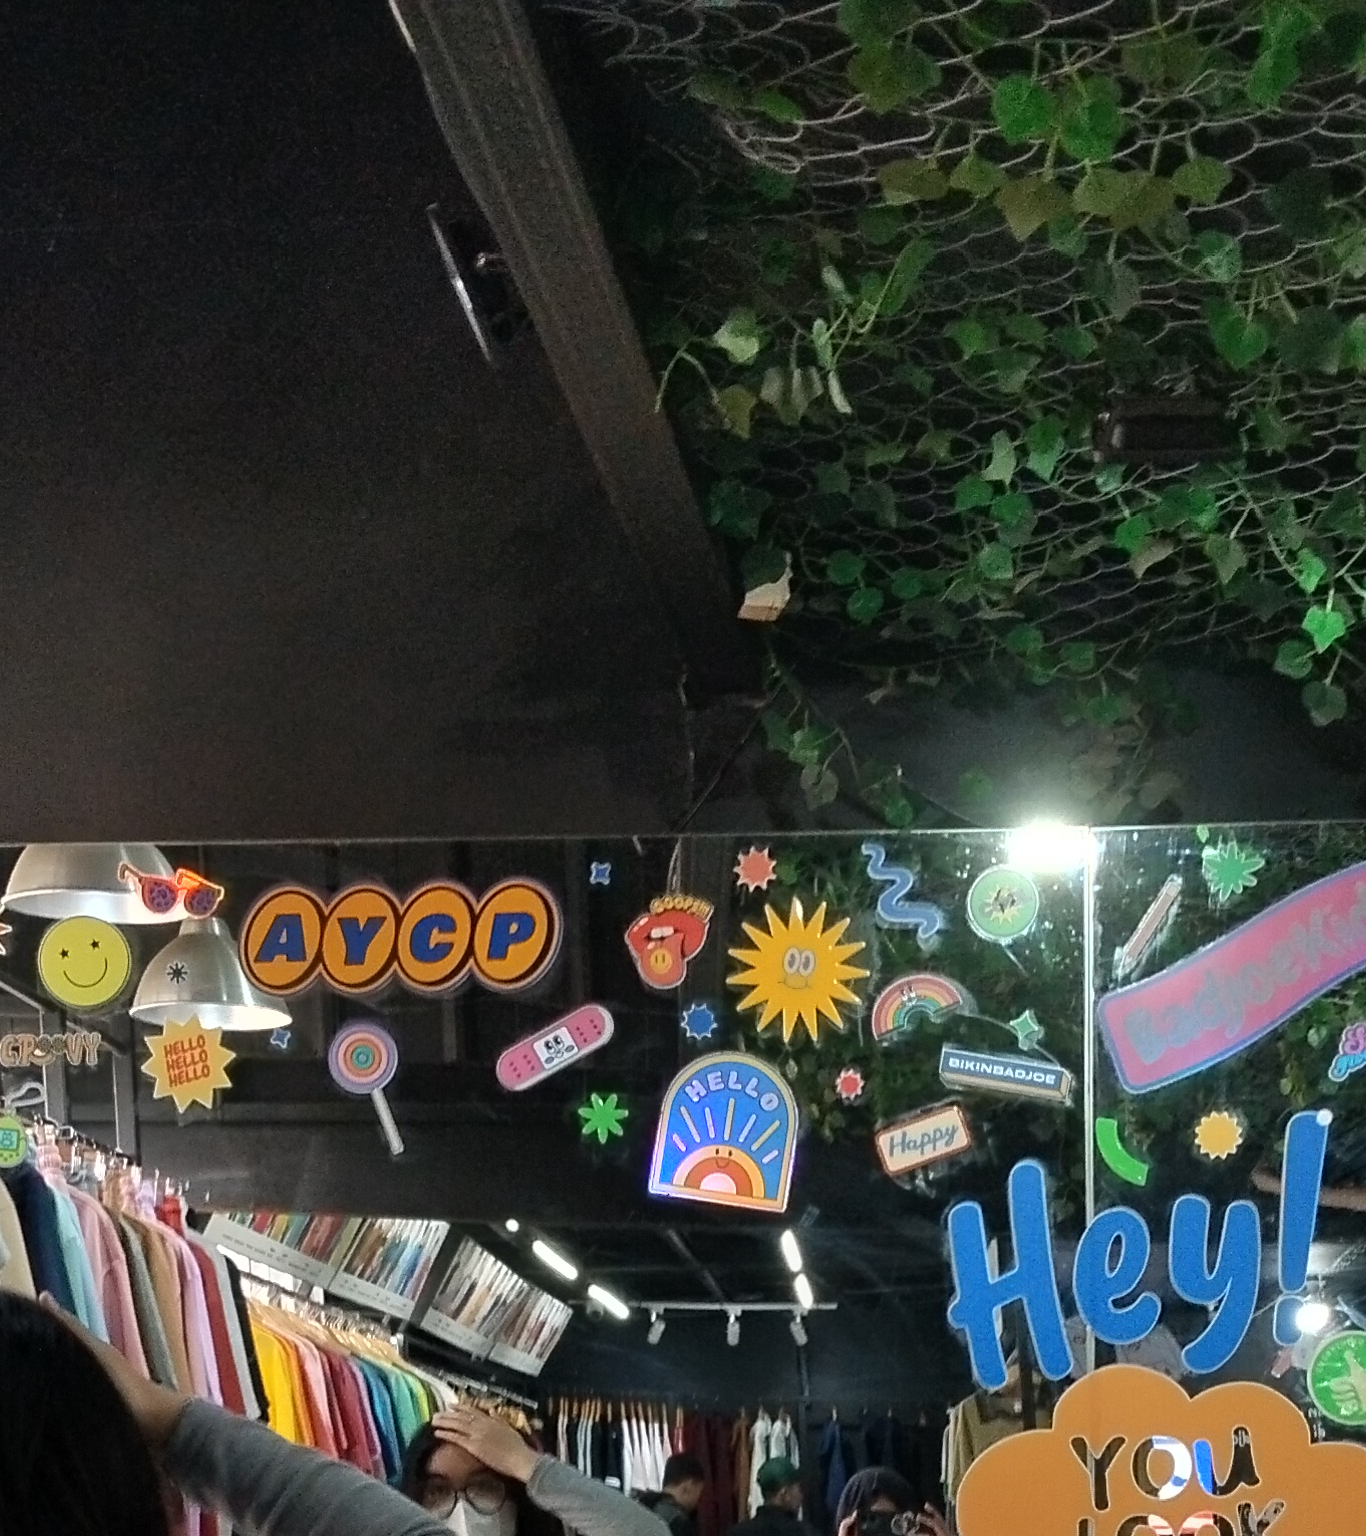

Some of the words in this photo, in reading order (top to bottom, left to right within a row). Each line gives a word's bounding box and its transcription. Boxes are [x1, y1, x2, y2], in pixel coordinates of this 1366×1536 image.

[253, 911, 536, 965] AYCP
[163, 1034, 206, 1056] HELLO
[166, 1051, 209, 1073] HELLO
[168, 1064, 211, 1088] HELLO
[948, 1056, 1057, 1085] BIKINBADJOE
[684, 1070, 780, 1112] HELLO
[888, 1123, 960, 1158] Happy
[947, 1110, 1332, 1391] Hey!
[1068, 1425, 1262, 1512] YOU
